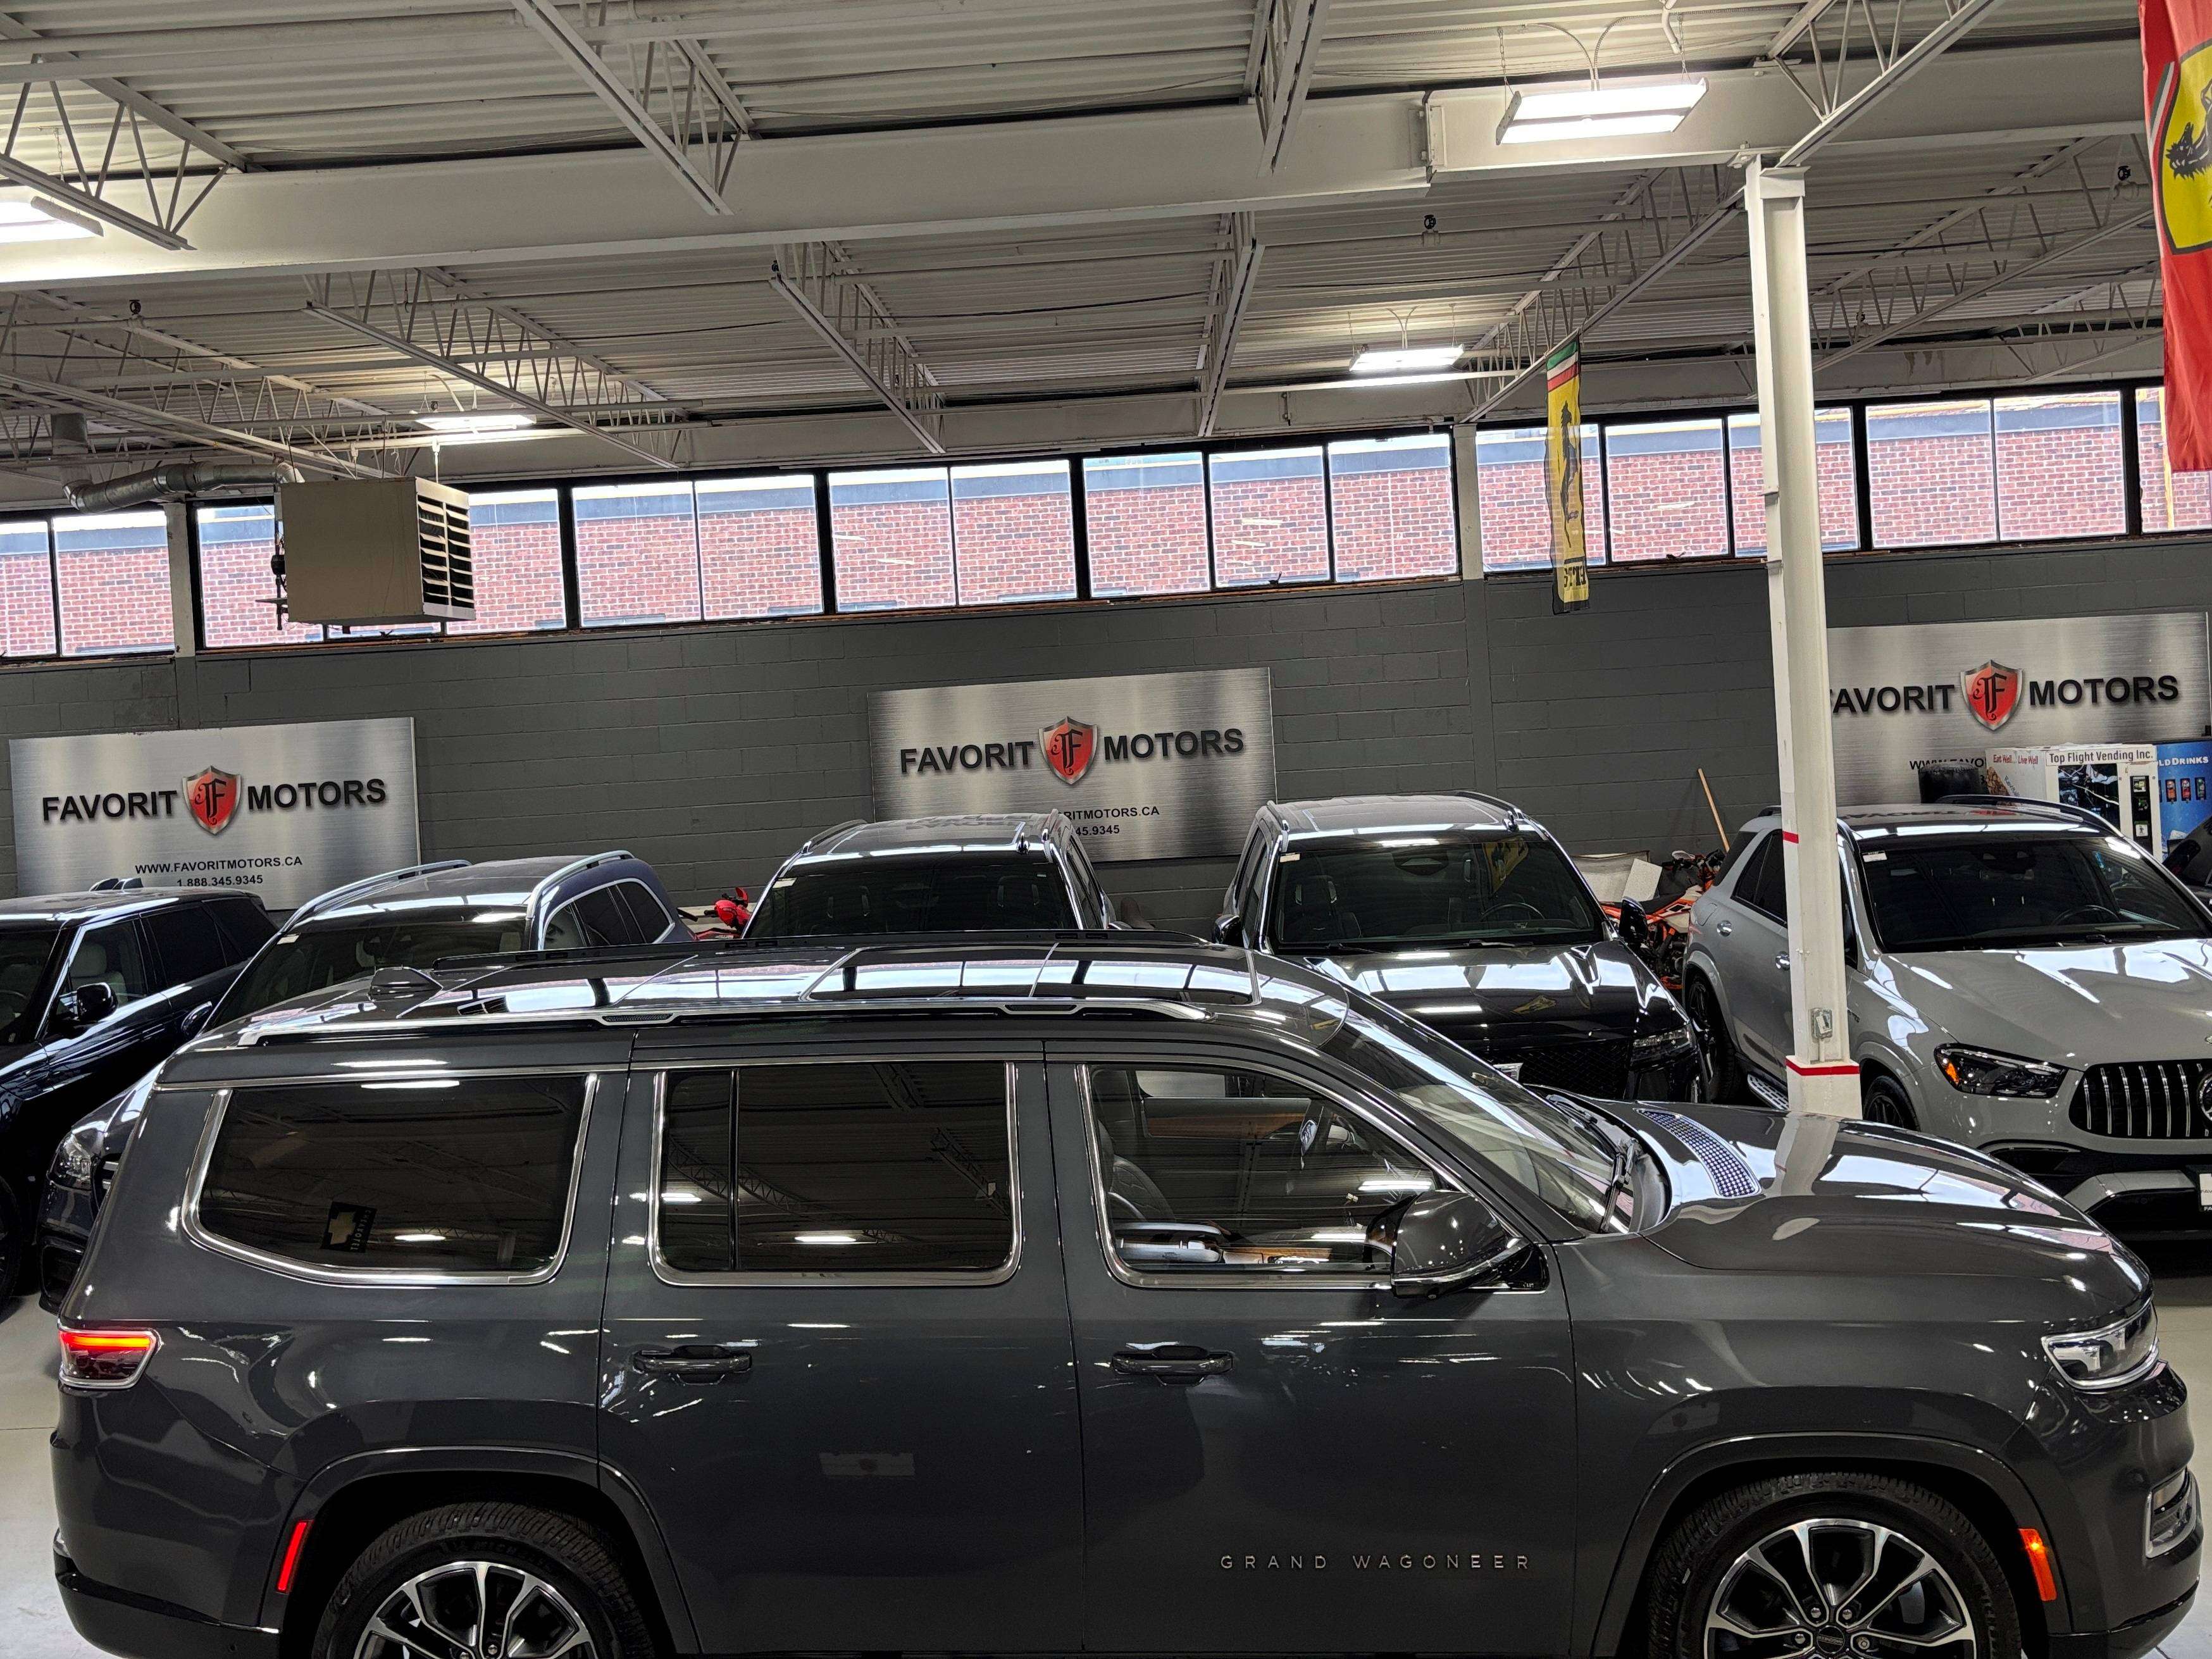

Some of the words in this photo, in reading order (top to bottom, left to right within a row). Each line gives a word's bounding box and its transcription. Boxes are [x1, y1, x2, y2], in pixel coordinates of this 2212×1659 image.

[1830, 684, 1954, 714] AVORIT
[2029, 675, 2178, 705] MOTORS
[900, 741, 1035, 773] FAVORIT
[1104, 728, 1244, 761] MOTORS
[2049, 753, 2065, 764] Top
[2067, 750, 2094, 764] Flight
[2097, 749, 2134, 762] Vending
[2136, 749, 2153, 759] Inc.
[2172, 756, 2209, 765] DRINKS
[42, 790, 177, 821] FAVORIT
[247, 778, 386, 810] MOTORS
[1059, 806, 1160, 823] RITMOTORS.CA
[135, 855, 302, 874] WWW.FAVORITMOTORS.CA
[177, 874, 263, 887] 1.888.345.9345
[1221, 1555, 1326, 1569] GRAND
[1352, 1555, 1529, 1569] WAGONEER
